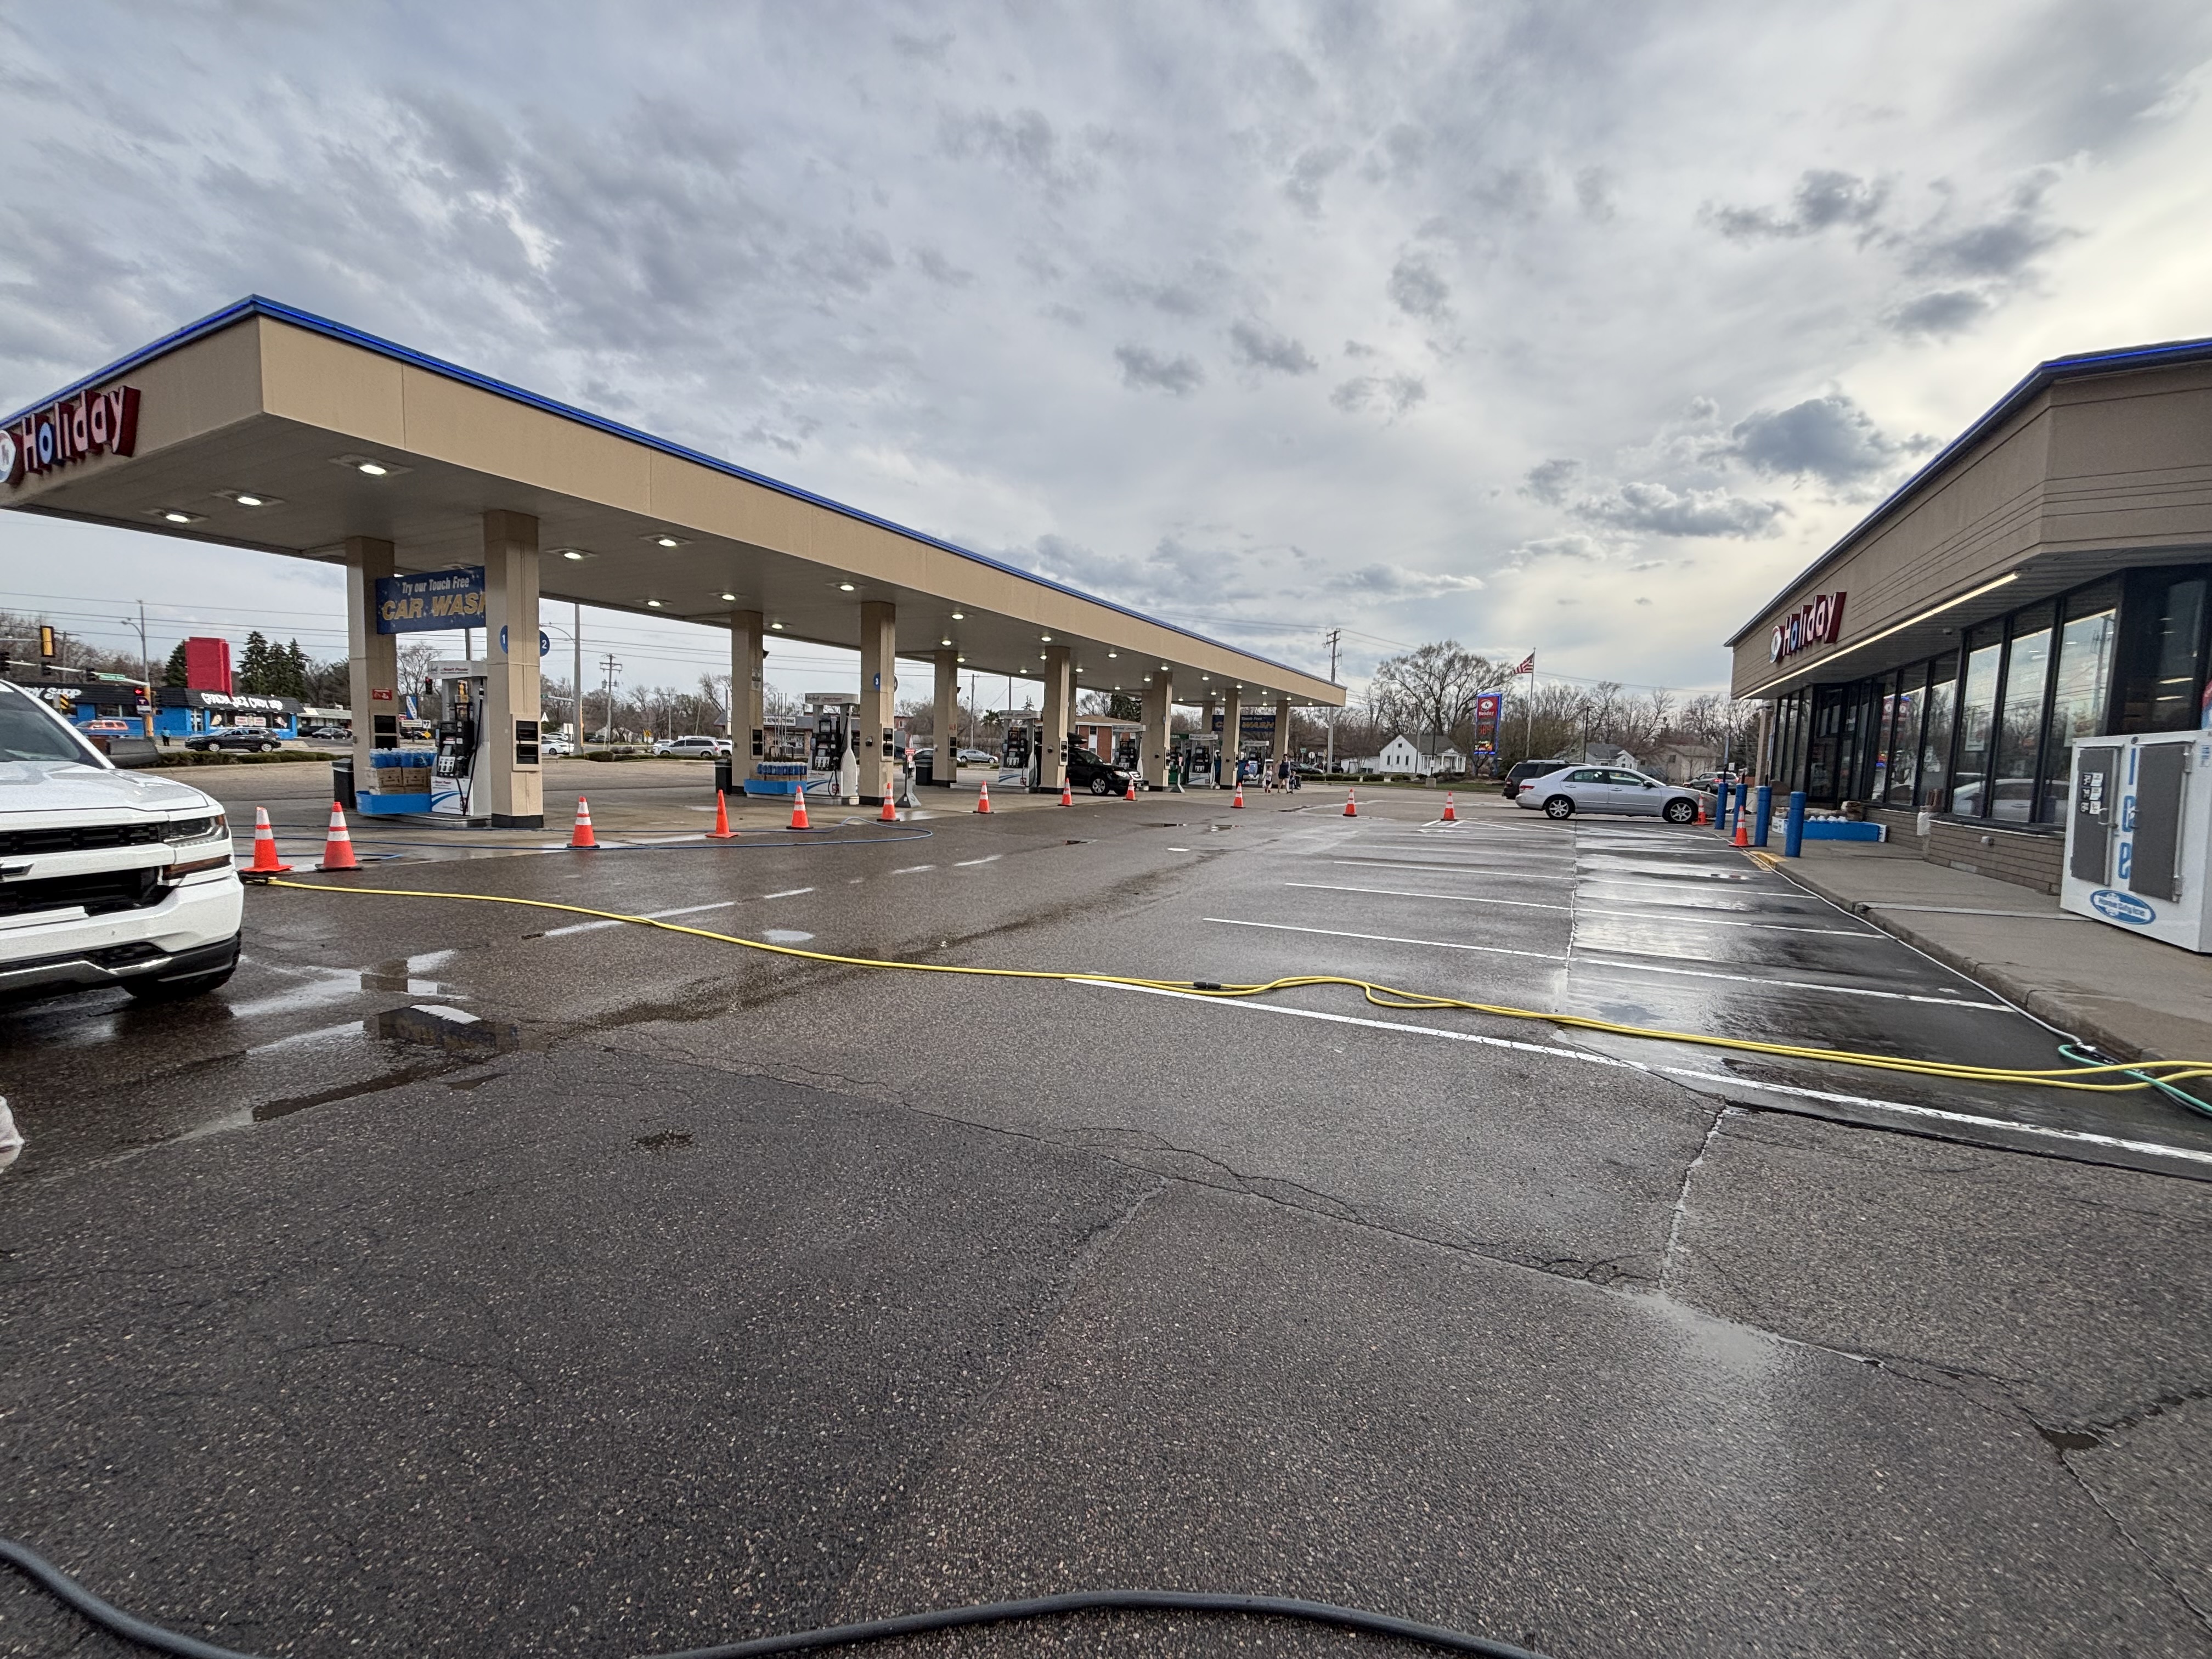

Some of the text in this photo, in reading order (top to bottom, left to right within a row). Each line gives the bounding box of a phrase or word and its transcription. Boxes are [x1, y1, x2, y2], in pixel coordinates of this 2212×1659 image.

[22, 386, 129, 473] Holiday
[402, 575, 470, 596] Try our Touch Free
[382, 597, 424, 621] CAR
[1782, 592, 1839, 657] Holiday
[501, 634, 505, 645] 1
[541, 640, 548, 650] 2
